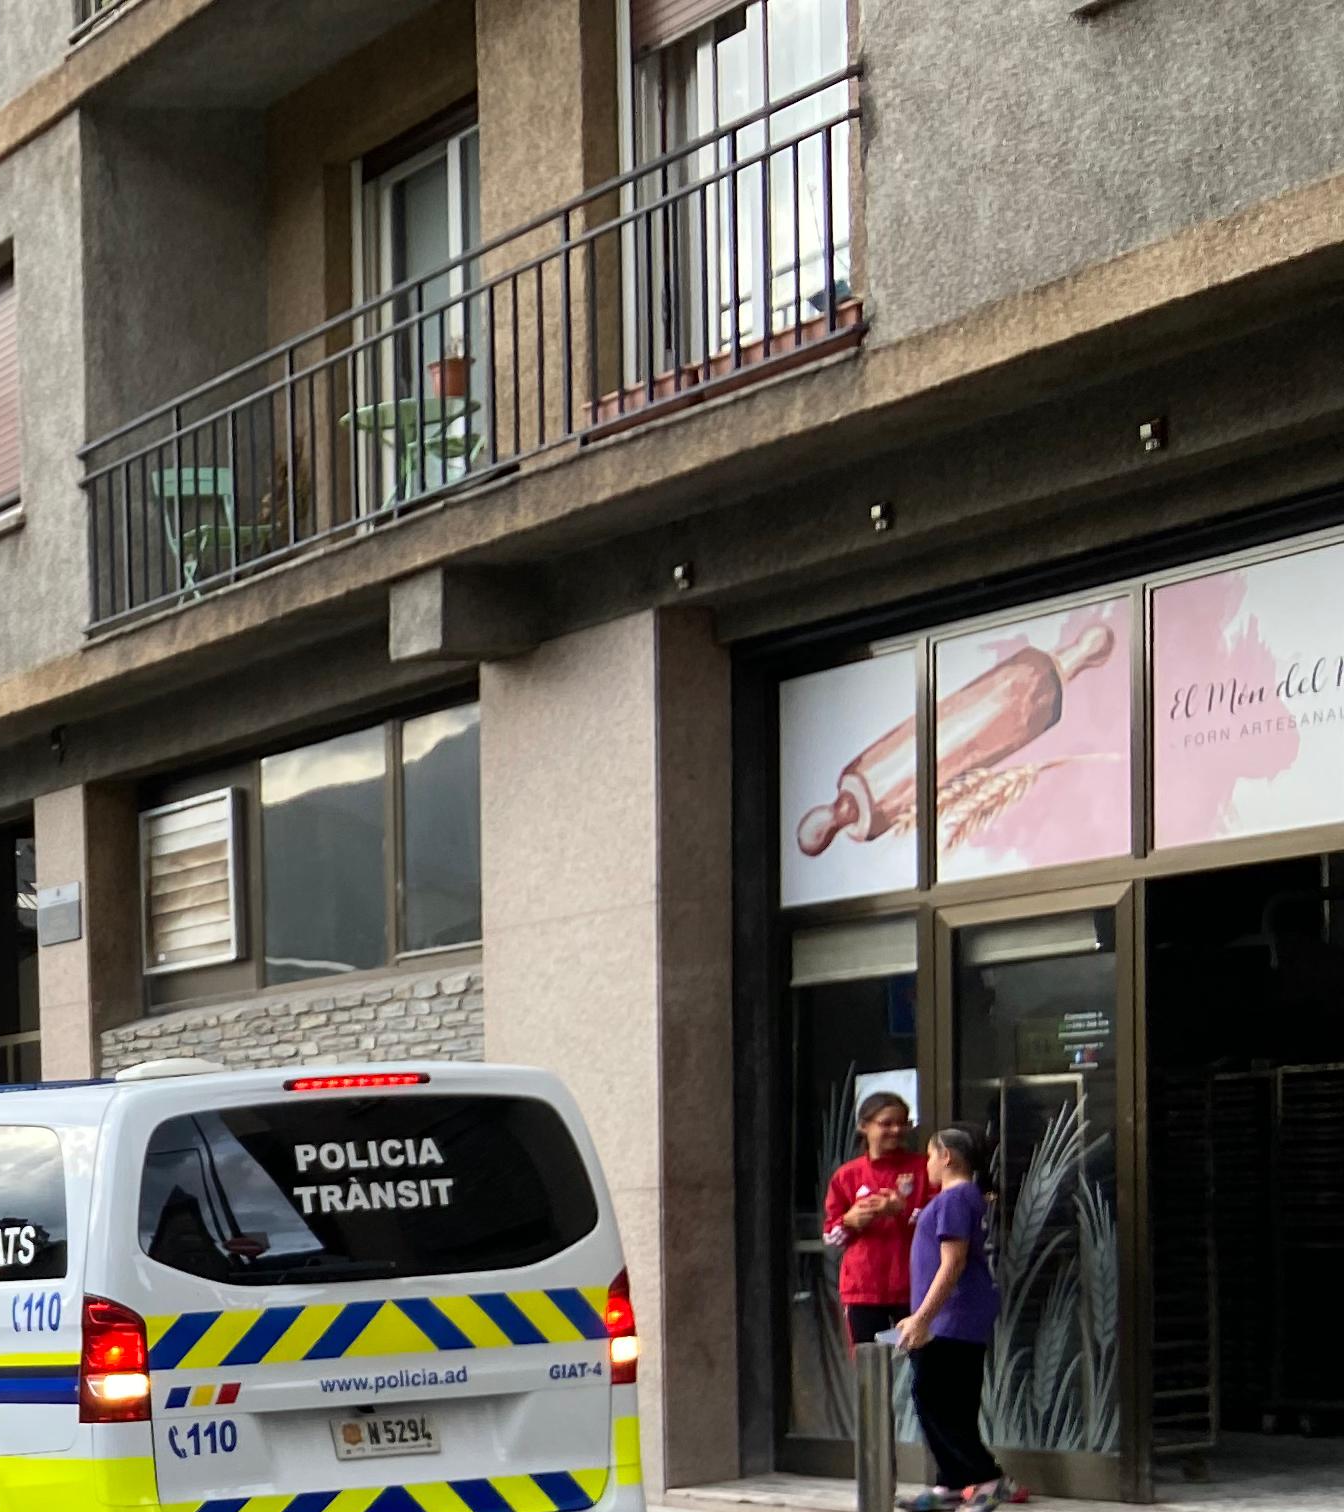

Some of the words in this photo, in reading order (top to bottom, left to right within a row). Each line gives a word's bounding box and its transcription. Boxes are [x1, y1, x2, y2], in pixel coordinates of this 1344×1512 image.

[1276, 656, 1328, 699] del
[1183, 727, 1231, 748] FORN
[294, 1137, 445, 1172] POLICIA
[293, 1177, 454, 1215] TRÀNSIT
[23, 1291, 61, 1332] 110
[320, 1366, 468, 1394] www.policia.ad
[549, 1361, 602, 1380] GIAT-4
[186, 1419, 238, 1456] 110
